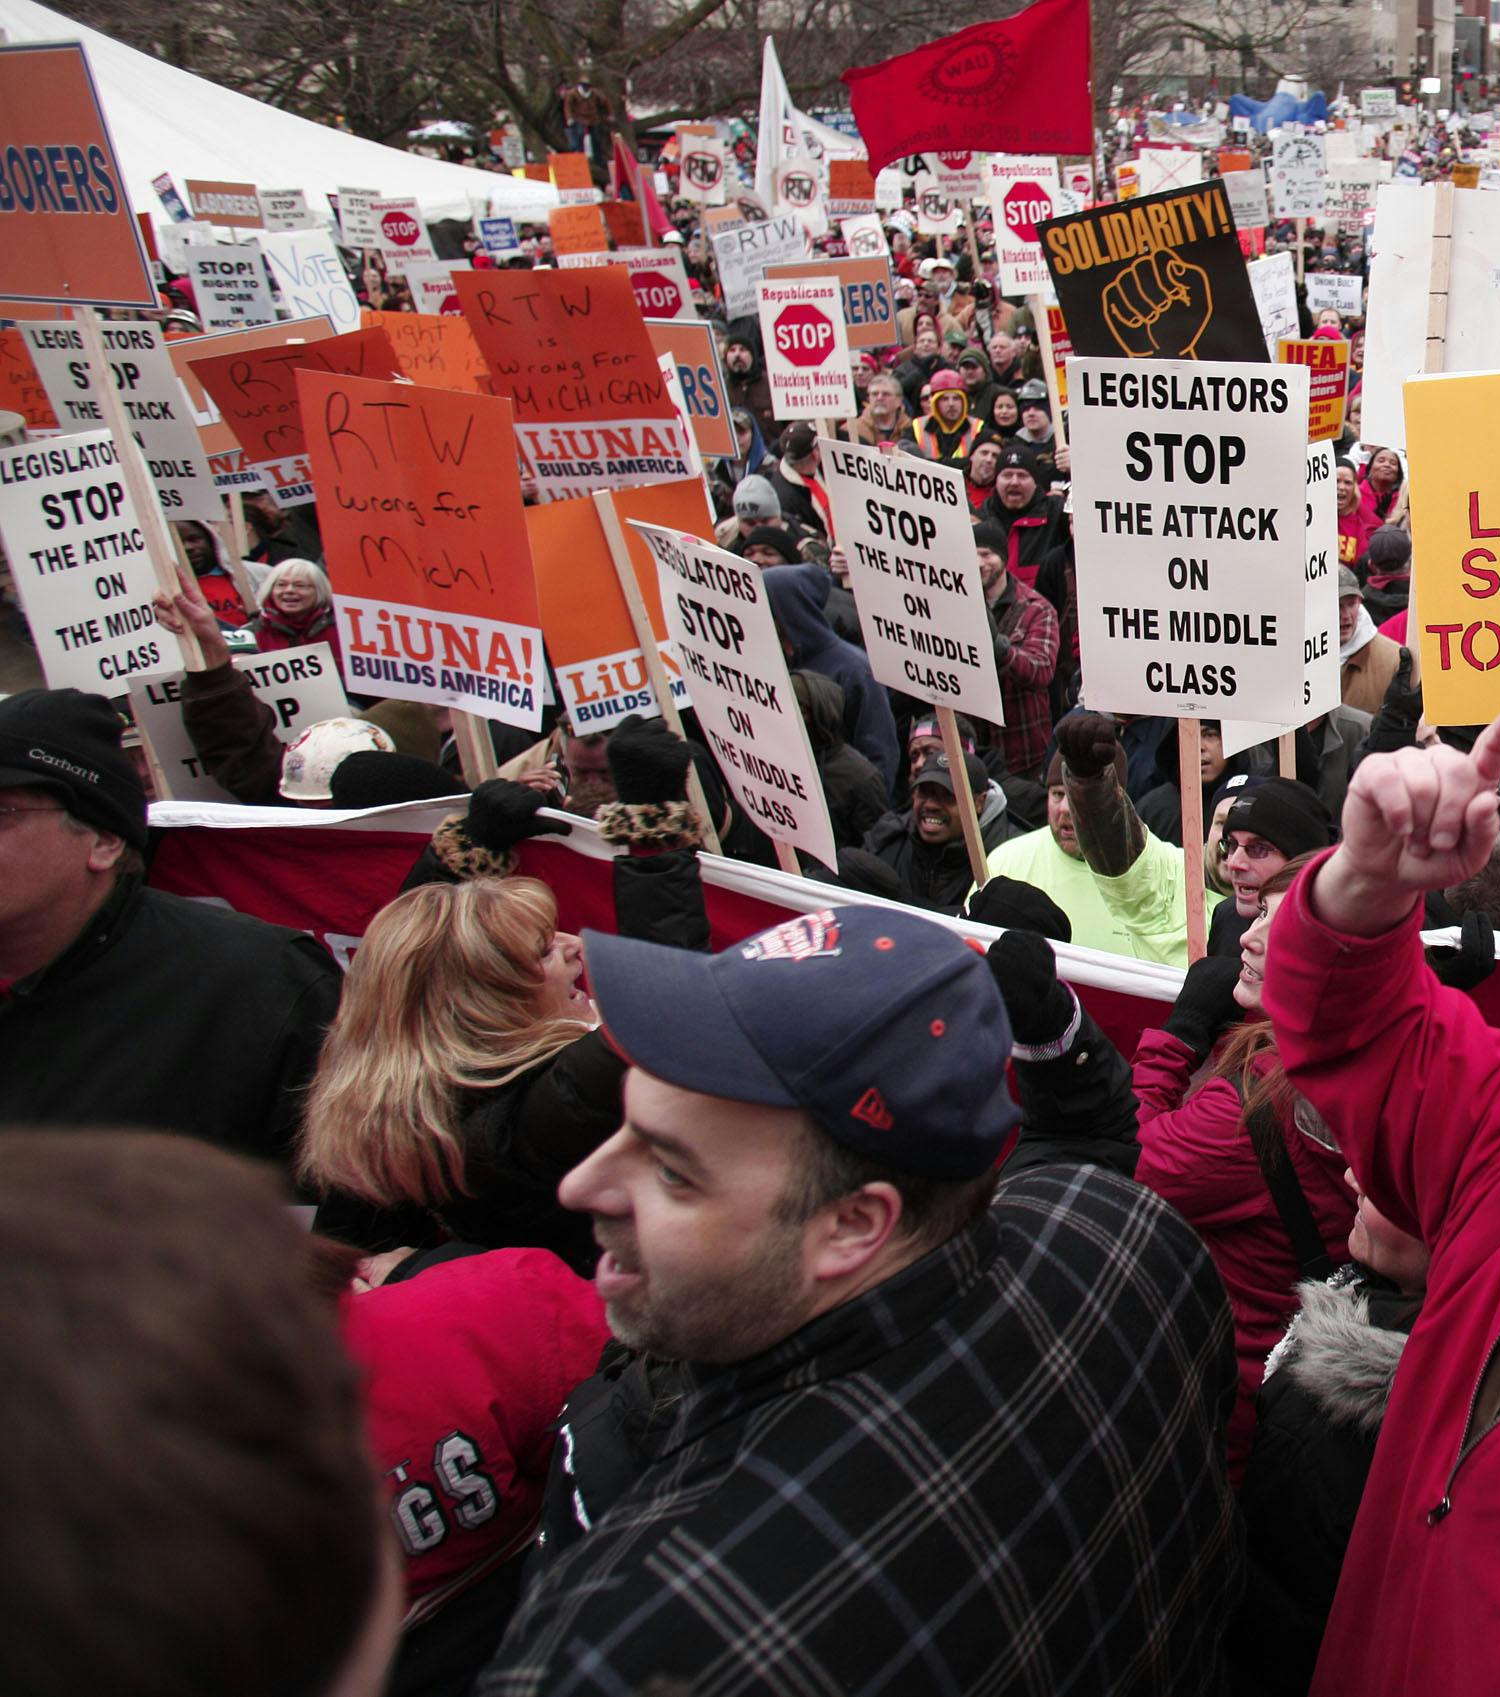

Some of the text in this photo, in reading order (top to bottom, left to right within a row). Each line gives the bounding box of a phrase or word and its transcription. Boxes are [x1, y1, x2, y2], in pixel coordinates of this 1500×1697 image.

[685, 157, 719, 183] RTW
[992, 163, 1053, 178] Republicans
[1340, 180, 1372, 190] know
[272, 201, 295, 210] STOP
[783, 176, 815, 201] RTW
[1342, 191, 1368, 201] bad
[382, 220, 417, 237] STOP
[1005, 200, 1052, 226] STOP
[737, 213, 797, 253] RTW
[1045, 187, 1231, 276] SOLIDARITY!
[198, 261, 255, 275] STOP!
[267, 246, 344, 287] VOTE
[1001, 248, 1038, 264] Attacking
[201, 279, 259, 289] RIGHT TO
[214, 293, 253, 302] WORK
[762, 287, 834, 303] Republicans
[231, 307, 244, 315] IN
[293, 287, 356, 325] NO
[476, 285, 592, 327] RTW
[1336, 300, 1355, 309] CLASS
[776, 322, 832, 350] STOP
[1286, 344, 1336, 369] UEA
[773, 372, 848, 390] Attacking Working
[1082, 372, 1288, 414] LEGISLATORS
[63, 400, 103, 420] THE
[785, 393, 839, 408] Americans
[325, 390, 474, 475] RTW
[524, 425, 683, 461] LiUNA!
[536, 458, 689, 478] BUILDS AMERICA
[1126, 431, 1246, 485] STOP
[831, 451, 958, 506] LEGISLATORS
[41, 481, 125, 531] STOP
[432, 491, 481, 522] for
[1095, 501, 1279, 541] THE ATTACK
[866, 498, 937, 550] STOP
[30, 547, 78, 576] THE
[359, 533, 495, 595] Mich!
[650, 534, 757, 604] LEGISLATORS
[854, 542, 968, 596] THE ATTACK
[1168, 557, 1209, 591] ON
[95, 571, 128, 600] ON
[676, 593, 745, 655] STOP
[903, 594, 931, 621] ON
[55, 620, 102, 651] THE
[872, 615, 981, 668] THE MIDDLE
[1103, 606, 1278, 646] THE MIDDLE
[99, 641, 160, 681] CLASS
[344, 606, 535, 686] LiUNA!
[350, 654, 535, 712] BUILDS AMERICA
[678, 643, 783, 714] THE ATTACK
[903, 660, 962, 697] CLASS
[1146, 662, 1237, 696] CLASS
[576, 690, 652, 723] BUILDS
[727, 706, 755, 740] ON
[709, 730, 808, 801] THE MIDDLE
[742, 786, 798, 831] CLASS
